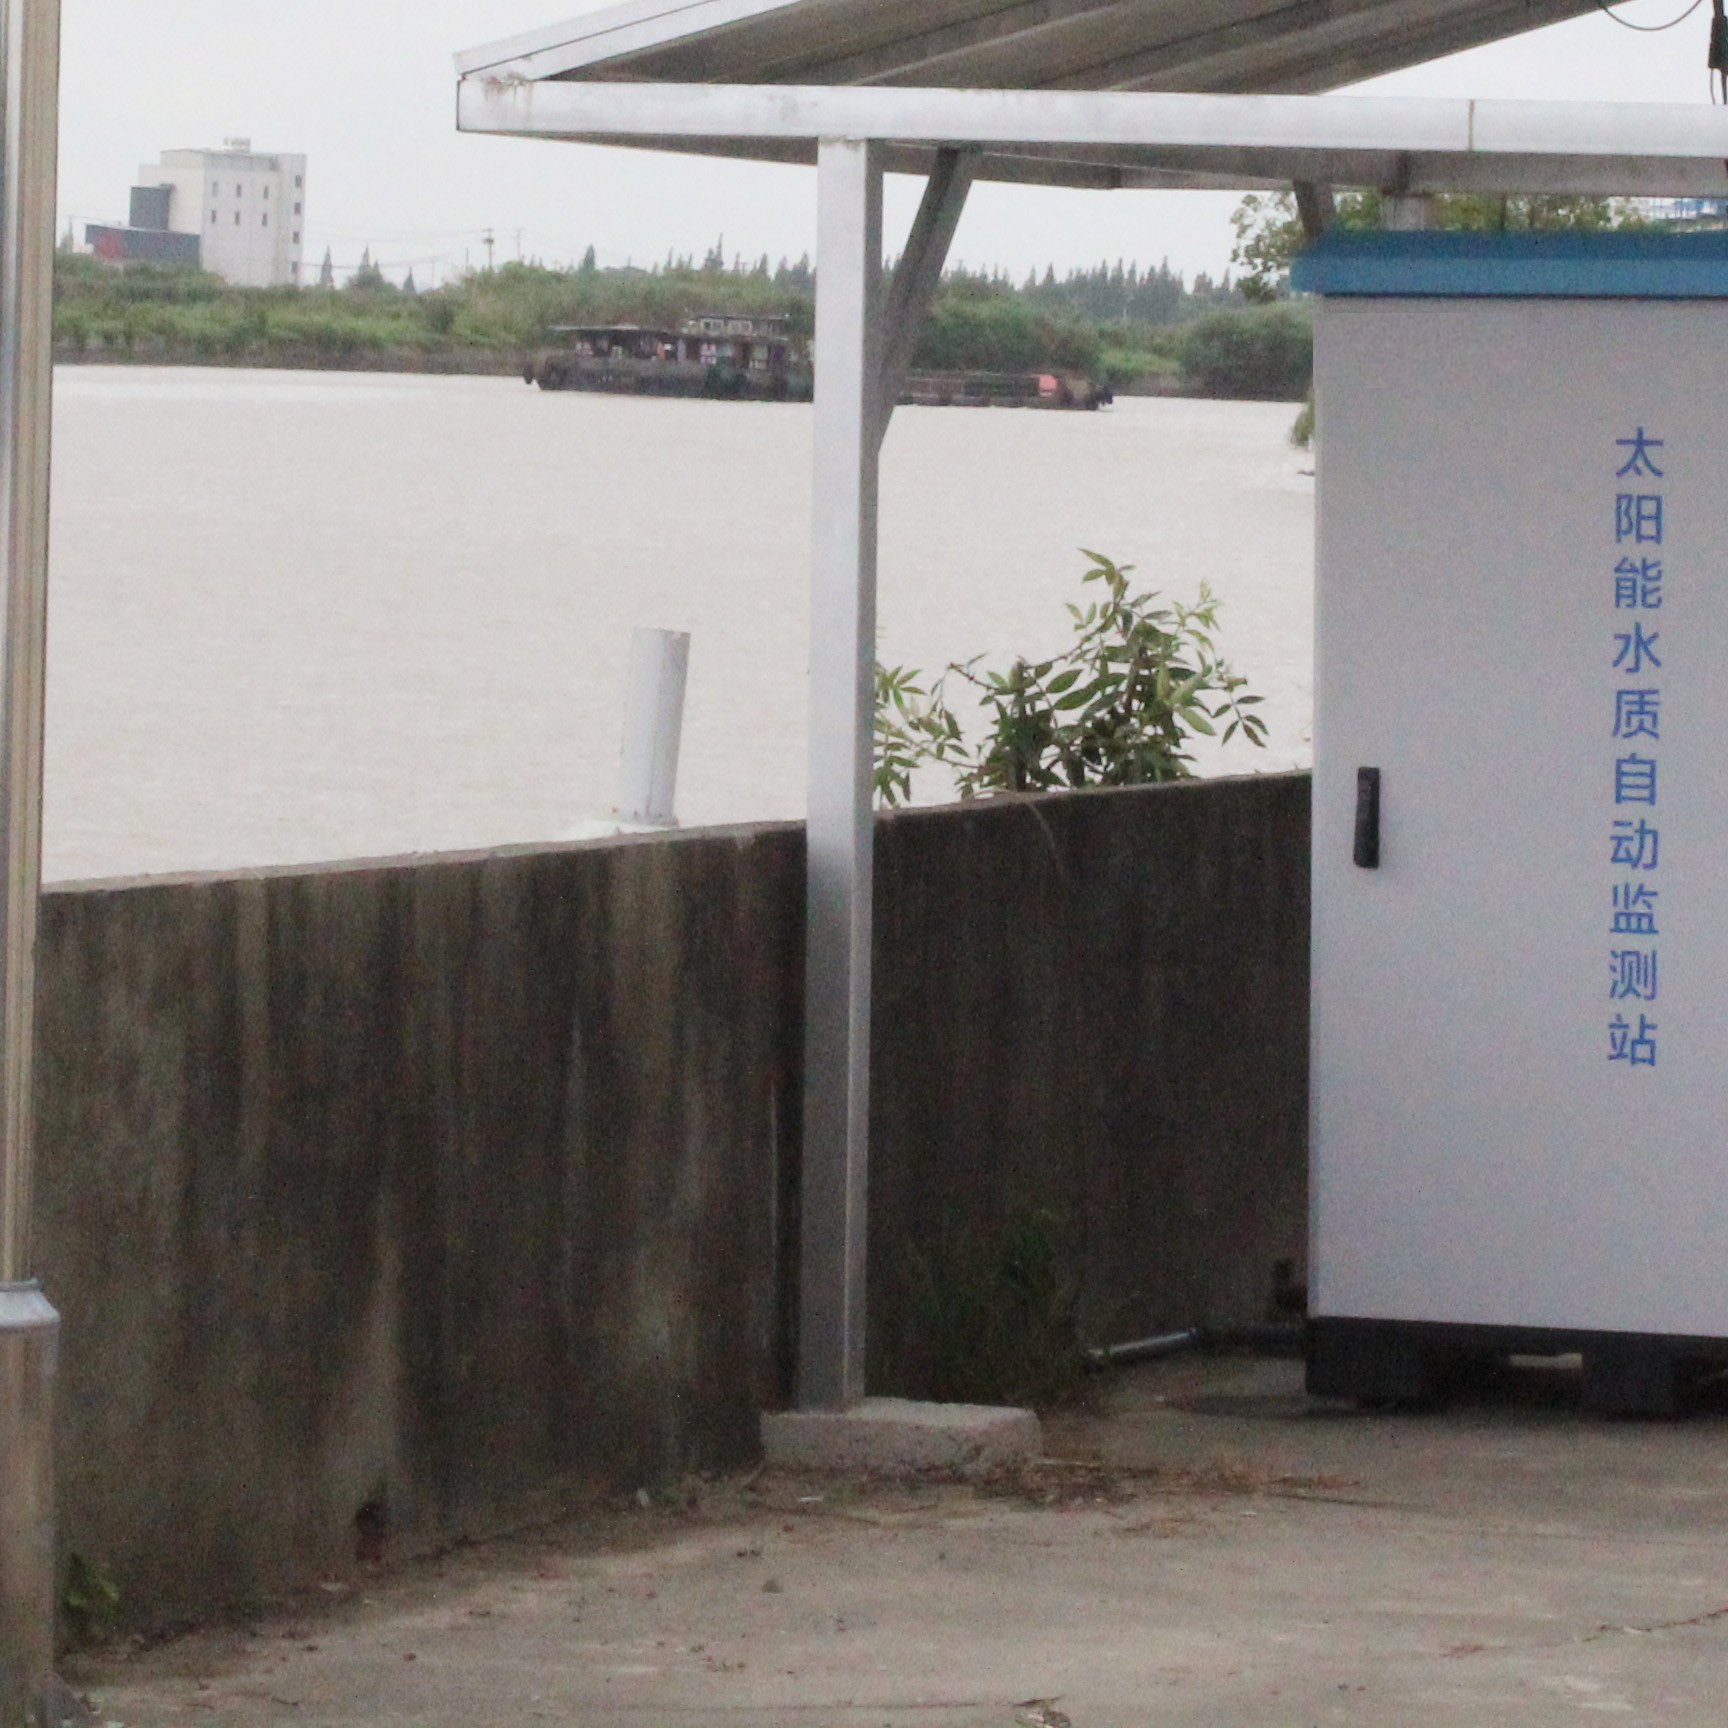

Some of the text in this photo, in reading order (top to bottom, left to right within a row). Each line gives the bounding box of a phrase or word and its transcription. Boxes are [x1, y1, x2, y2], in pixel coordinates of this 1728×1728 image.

[1607, 426, 1664, 1067] 太阳能水质自动监测站
